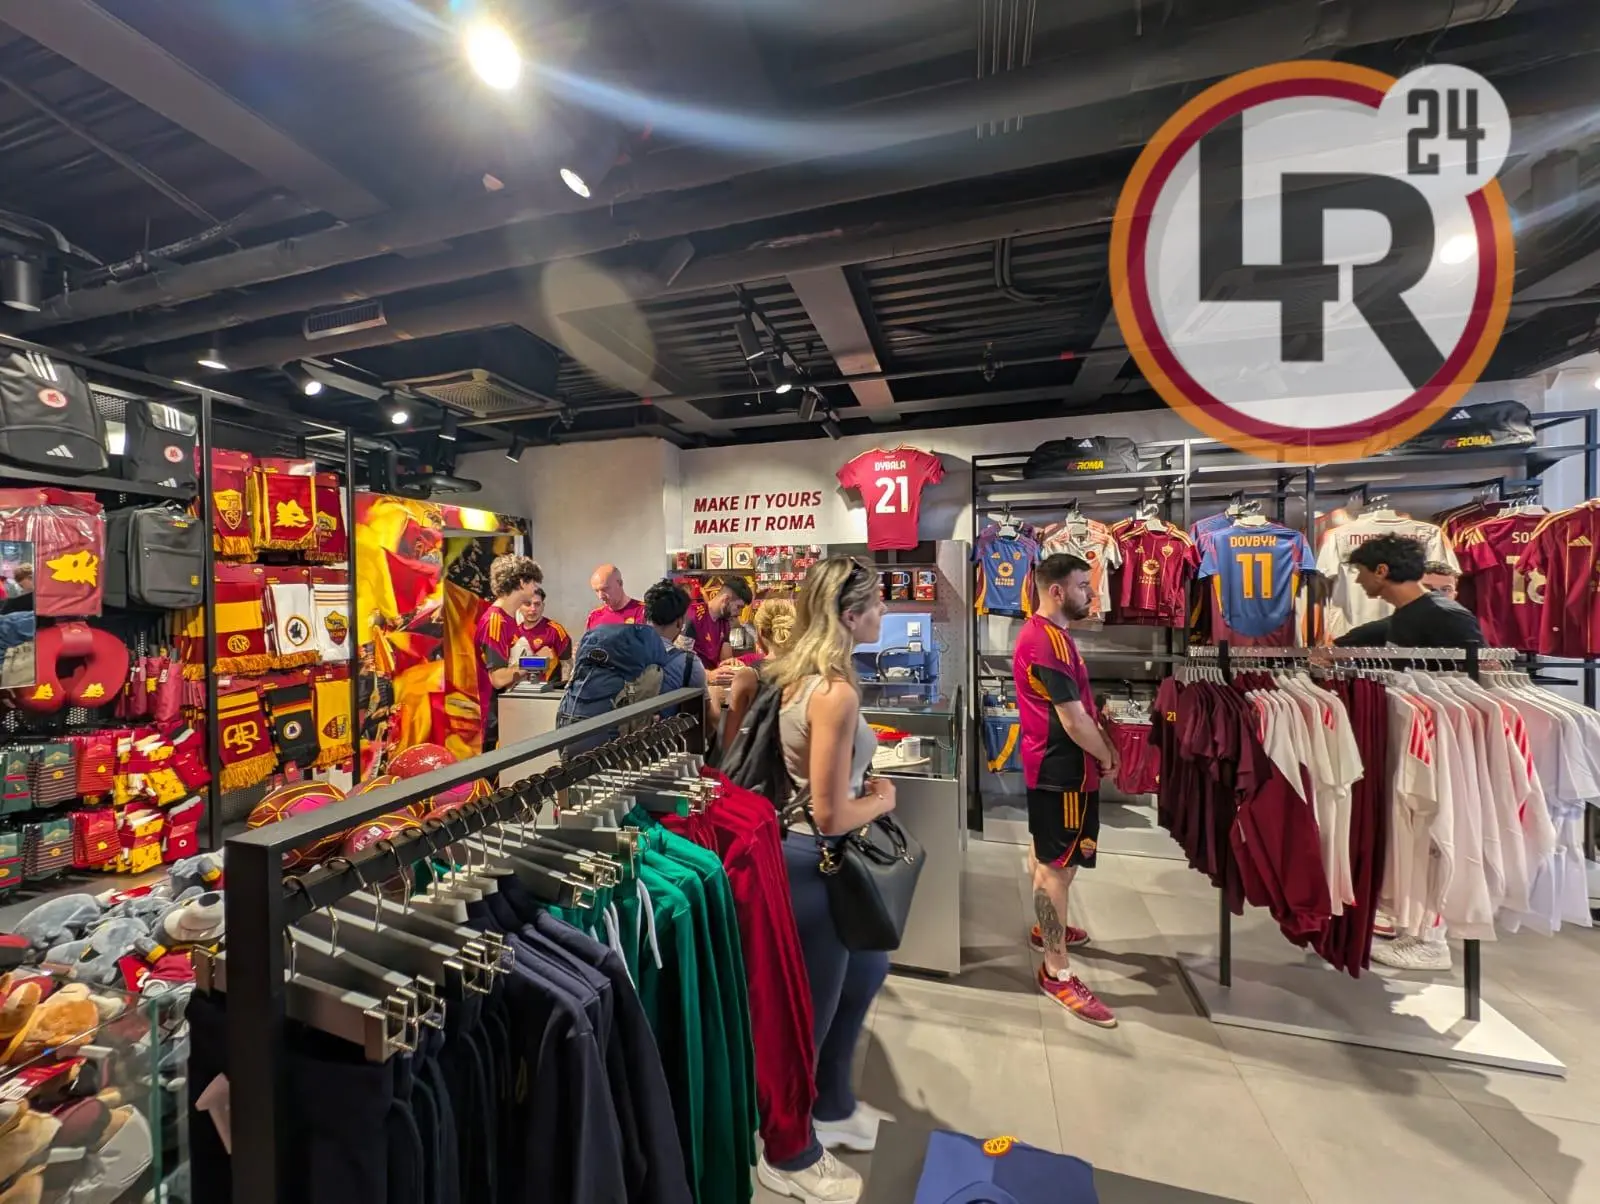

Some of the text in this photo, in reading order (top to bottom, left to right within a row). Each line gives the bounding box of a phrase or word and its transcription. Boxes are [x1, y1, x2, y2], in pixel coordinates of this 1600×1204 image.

[874, 459, 906, 472] DYBALA
[693, 491, 823, 513] MAKE IT YOURS
[875, 475, 909, 514] 21
[693, 514, 816, 535] MAKE IT ROMA
[1230, 535, 1277, 548] DOVBYK
[1236, 552, 1273, 599] 11
[1166, 711, 1177, 722] 21
